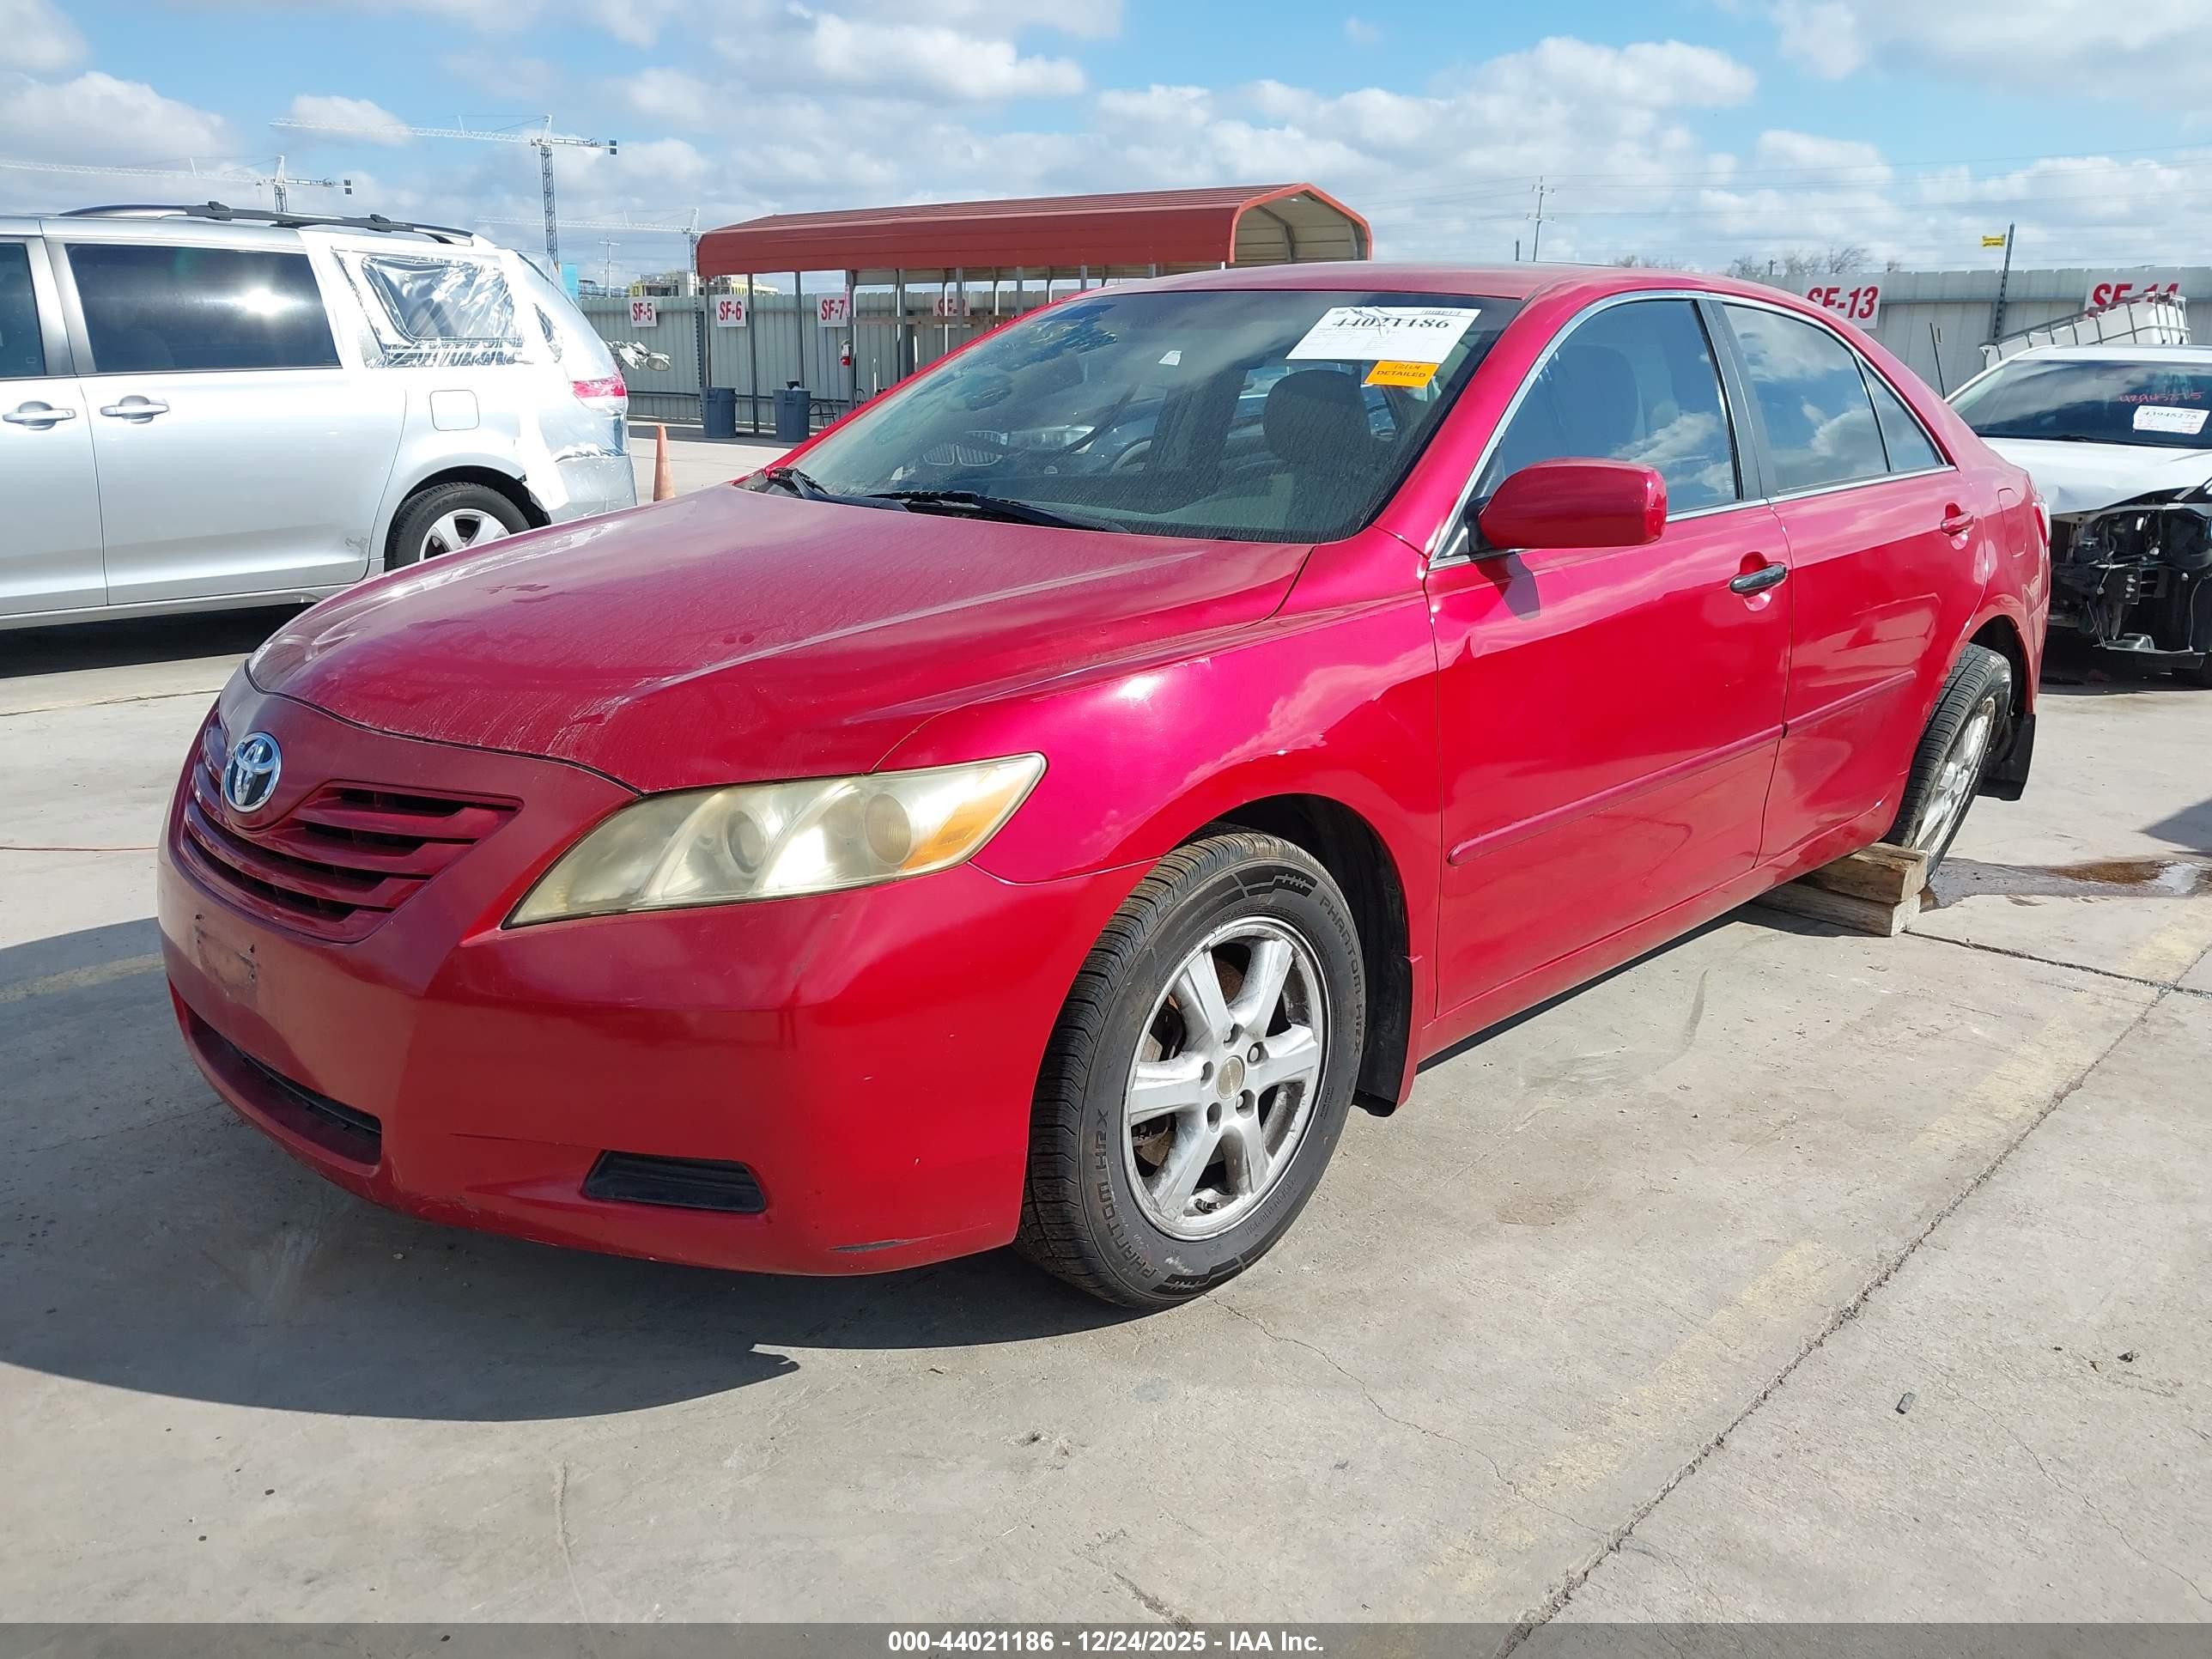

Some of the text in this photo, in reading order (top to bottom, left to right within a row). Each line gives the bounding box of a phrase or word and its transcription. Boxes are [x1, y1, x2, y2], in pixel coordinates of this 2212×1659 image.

[633, 302, 653, 321] SF-5
[720, 301, 742, 320] SF-6
[821, 299, 845, 320] SF-7
[1332, 318, 1452, 329] 44021186
[1319, 895, 1363, 994] PHANTOM
[1097, 1180, 1158, 1279] PHANTOM
